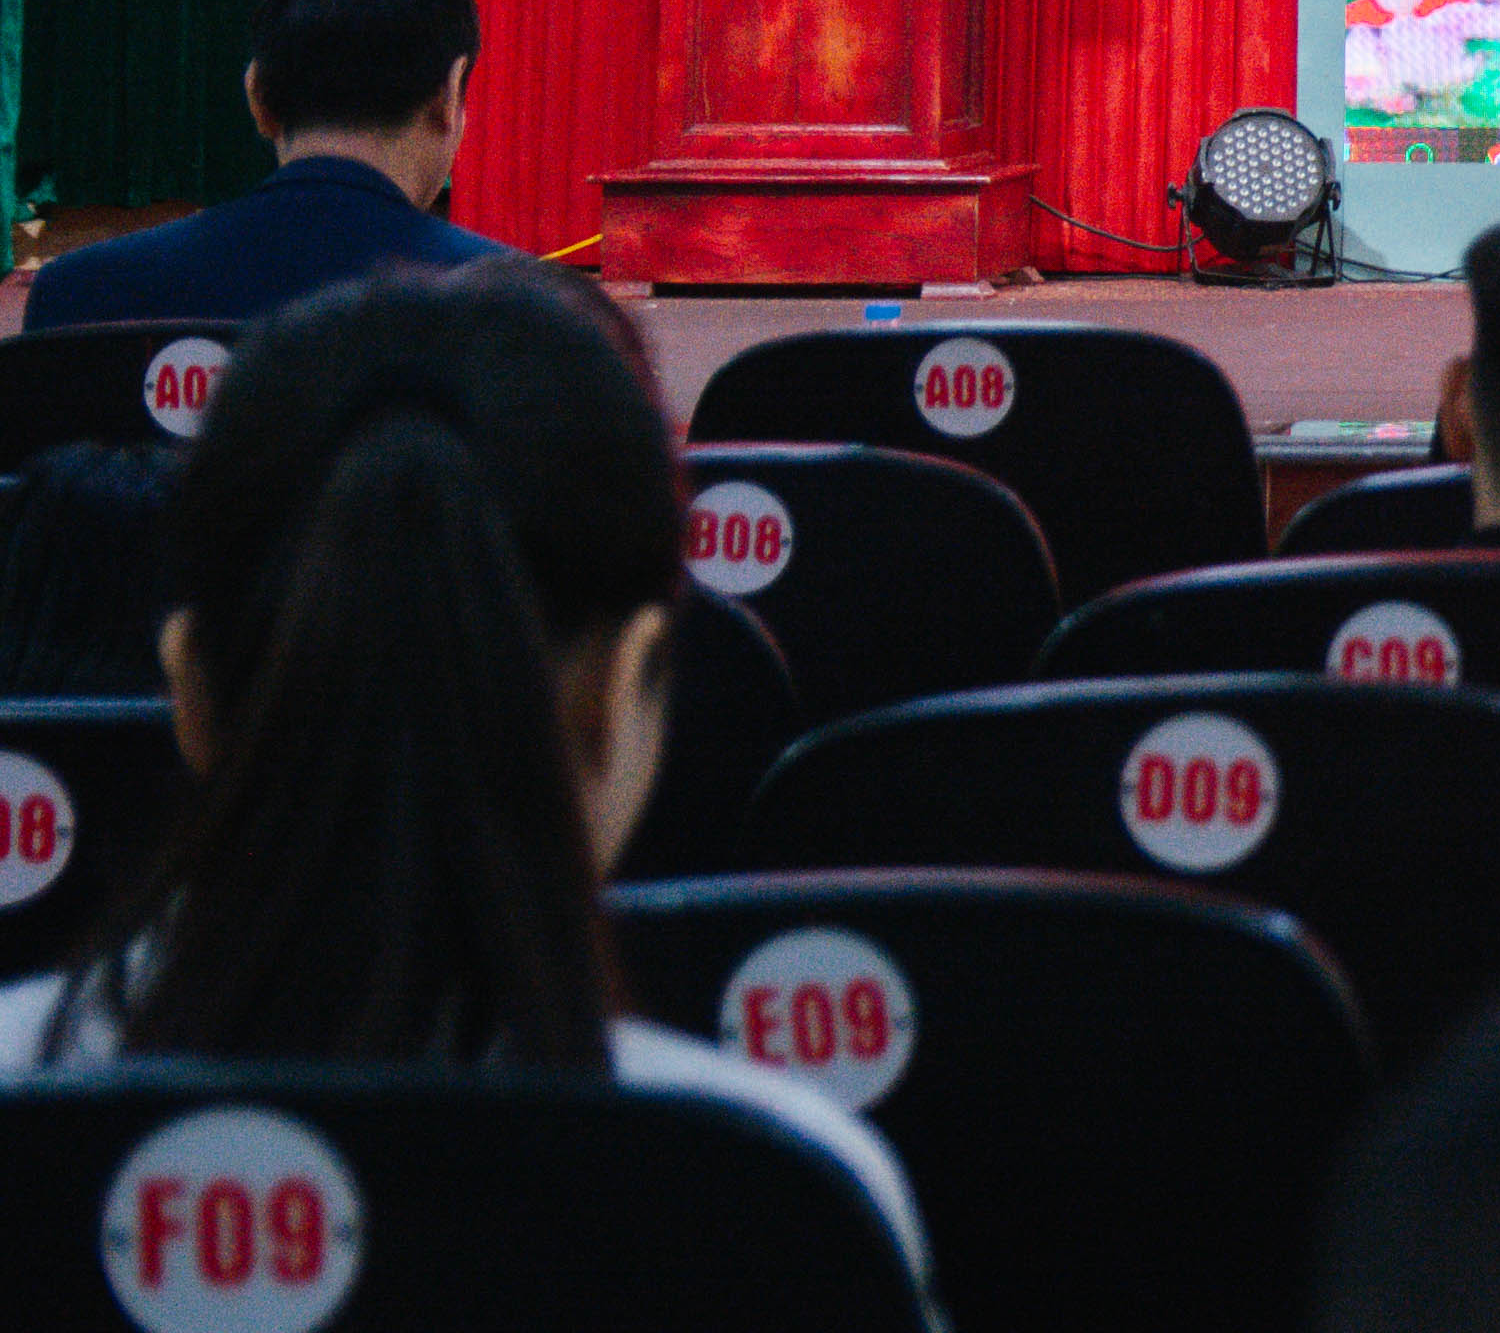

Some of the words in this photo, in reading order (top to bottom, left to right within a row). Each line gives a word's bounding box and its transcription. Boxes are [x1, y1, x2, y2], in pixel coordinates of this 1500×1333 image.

[925, 365, 1005, 409] A08
[687, 510, 782, 565] B08
[1137, 755, 1262, 826] D09
[744, 980, 889, 1064] E09
[141, 1180, 324, 1287] F09
